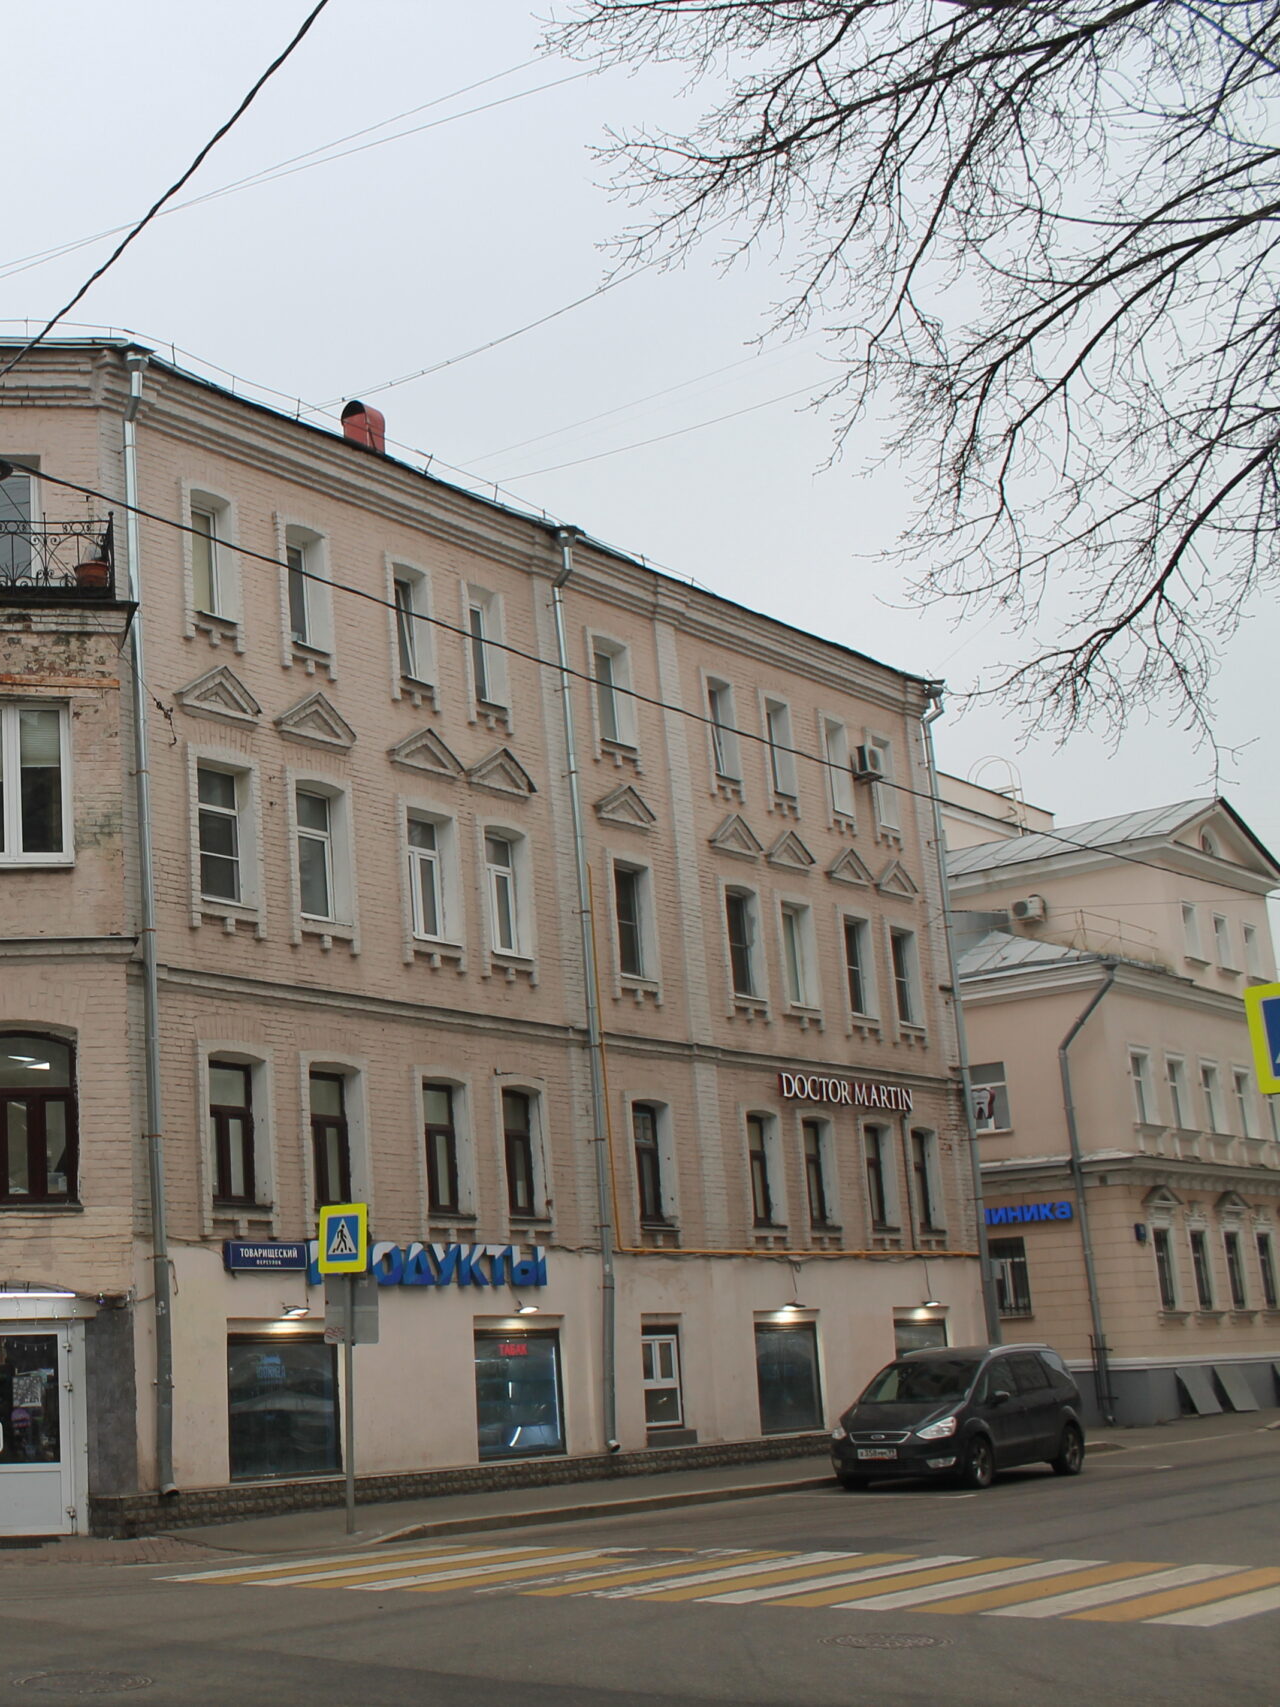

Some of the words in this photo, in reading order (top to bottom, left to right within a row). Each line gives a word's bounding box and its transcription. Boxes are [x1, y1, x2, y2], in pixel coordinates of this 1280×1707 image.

[780, 1072, 852, 1105] DOCTOR
[854, 1083, 914, 1111] MARTIN
[239, 1247, 298, 1259] ТОВАРИЩЕСКИЙ
[307, 1240, 548, 1286] ОДУКТЫ
[498, 1343, 528, 1356] ТАБАК
